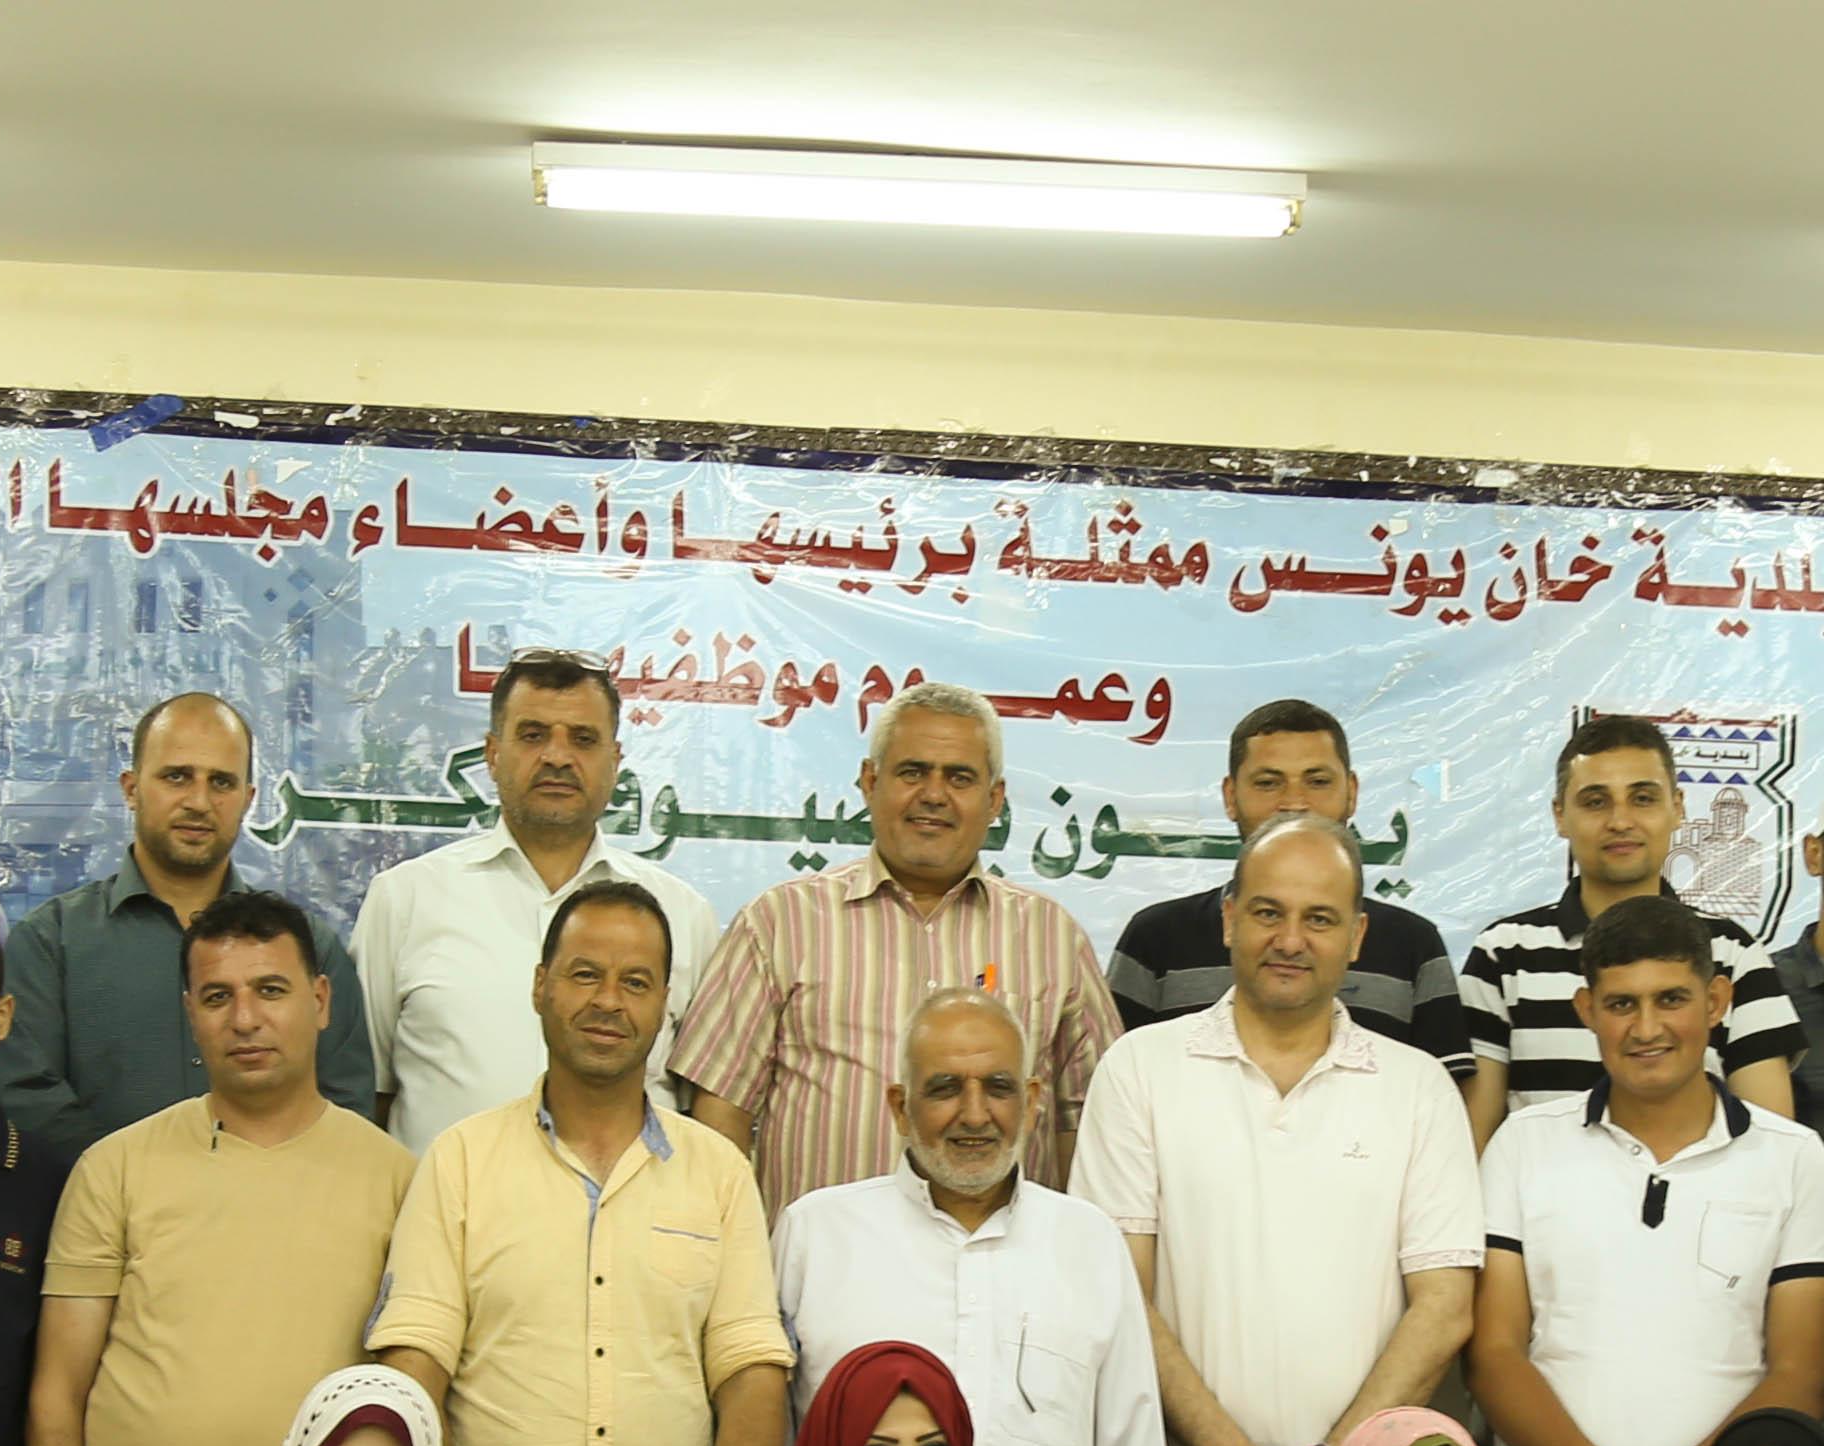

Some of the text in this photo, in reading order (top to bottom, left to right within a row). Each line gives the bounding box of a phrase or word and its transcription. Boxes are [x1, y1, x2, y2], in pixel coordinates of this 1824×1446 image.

[49, 459, 328, 562] مجلسها
[353, 474, 648, 578] وأعضاء
[673, 497, 976, 603] برئيسها
[997, 499, 1209, 588] ممثلة
[1229, 523, 1471, 624] يونس
[1486, 534, 1613, 620] خان
[859, 665, 1172, 744] وعمم
